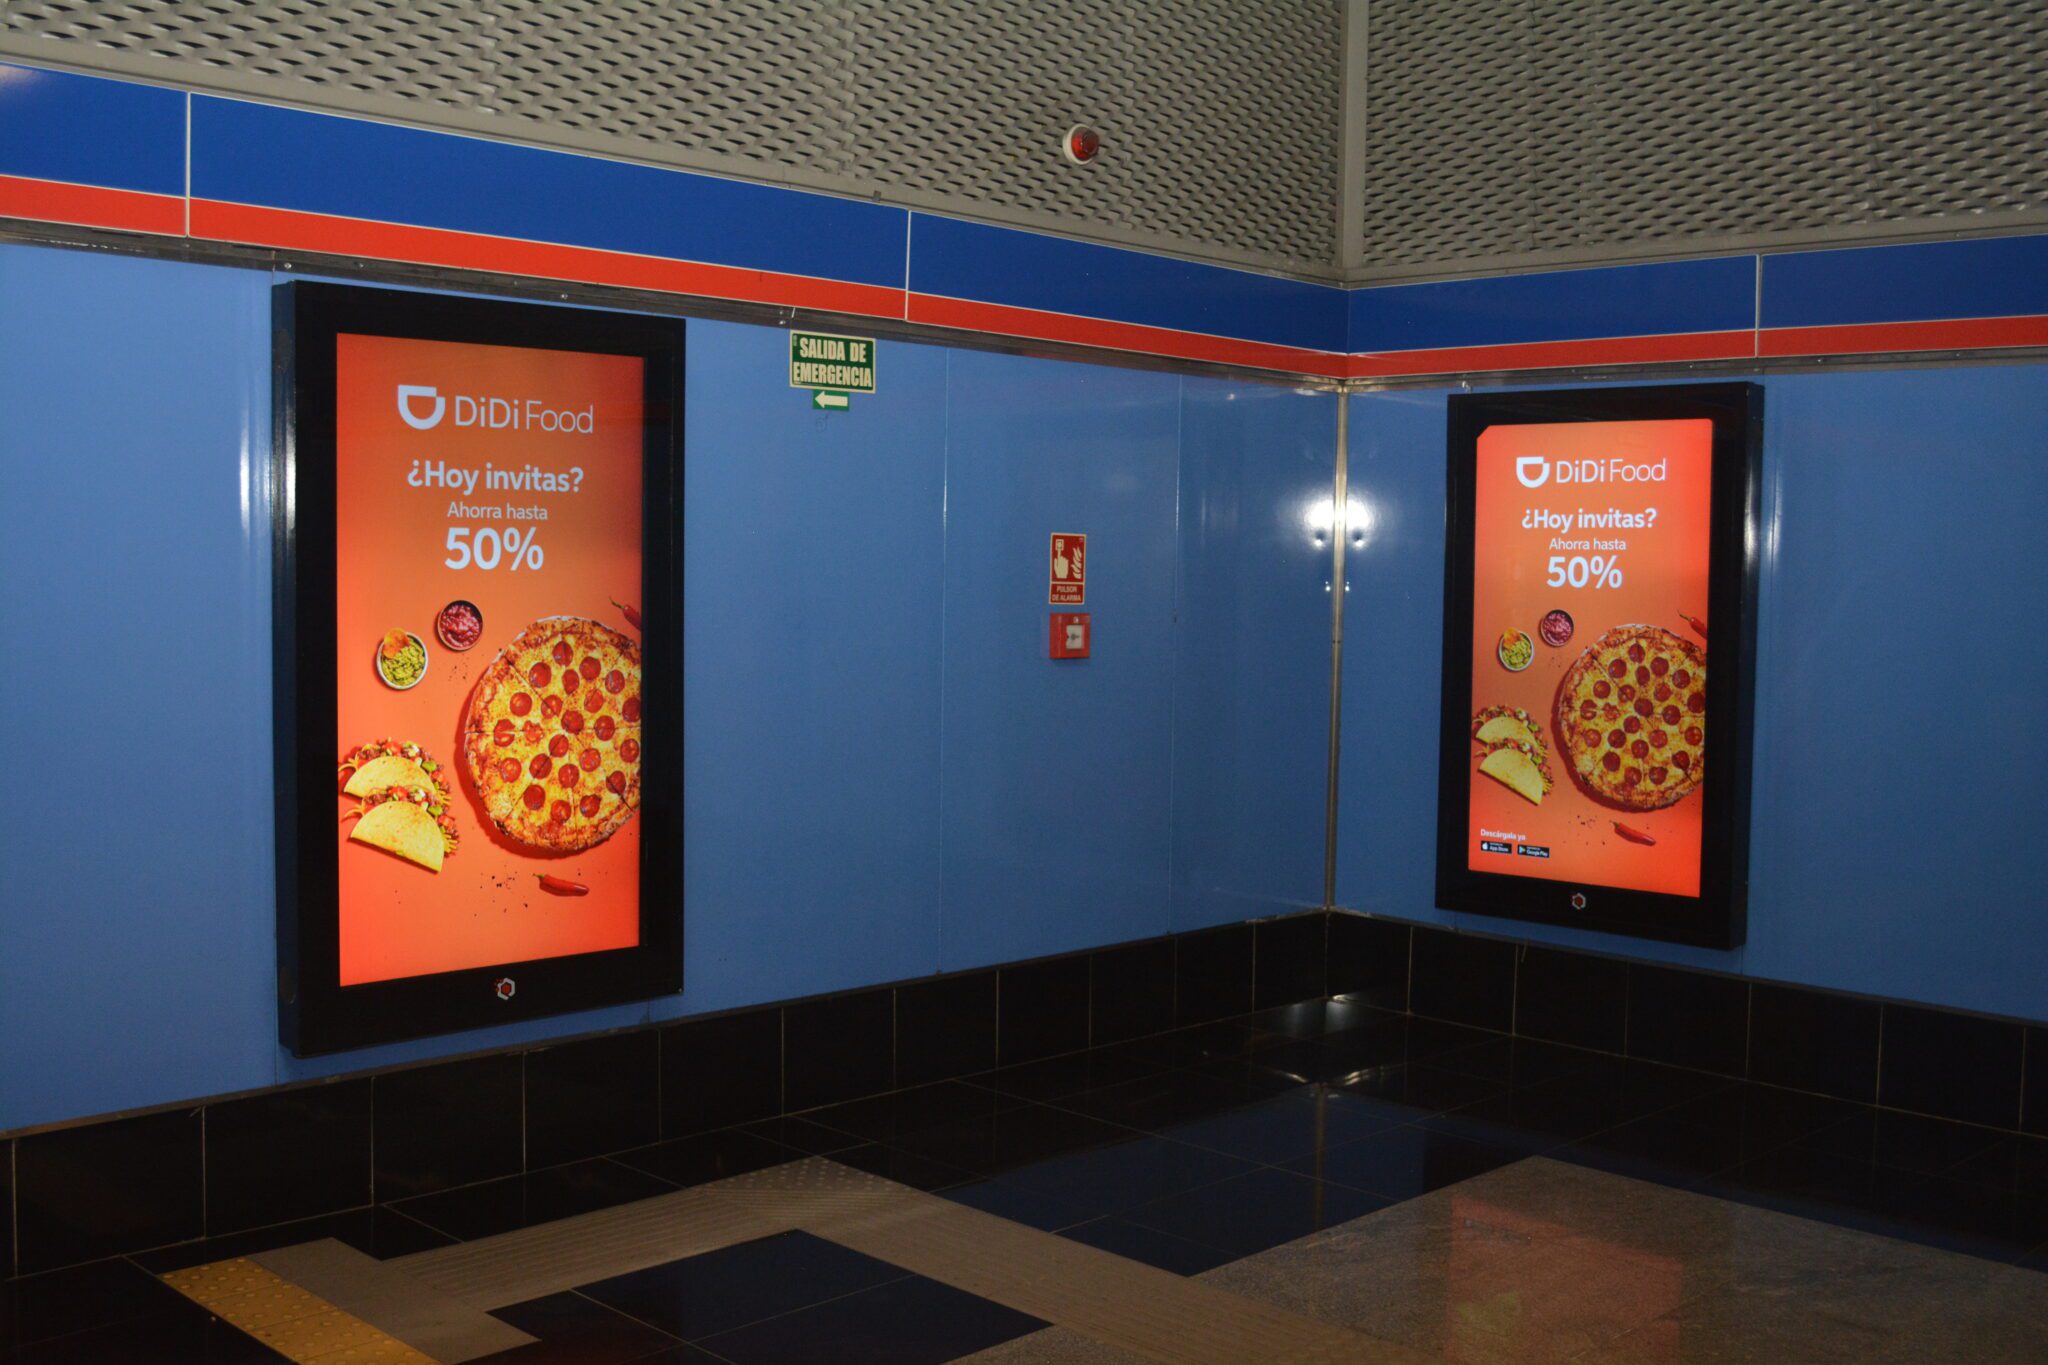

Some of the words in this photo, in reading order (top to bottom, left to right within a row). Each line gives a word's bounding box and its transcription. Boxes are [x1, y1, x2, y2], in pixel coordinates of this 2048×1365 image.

[800, 337, 845, 361] SALIDA
[849, 342, 866, 362] DE
[793, 362, 872, 387] EMERGENCIA
[455, 395, 519, 430] DiDi
[526, 400, 593, 433] Food
[407, 459, 479, 496] ¿Hoy
[485, 462, 584, 493] invitas?
[1556, 459, 1605, 483] DiDi
[1609, 458, 1667, 482] Food
[447, 501, 502, 519] Ahorra
[506, 503, 548, 520] hasta
[1521, 508, 1574, 534] ¿Hoy
[1577, 507, 1658, 529] invitas?
[444, 526, 544, 572] 50%
[1549, 538, 1590, 550] Ahorra
[1593, 538, 1627, 550] hasta
[1546, 555, 1623, 589] 50%
[1517, 834, 1526, 842] ya
